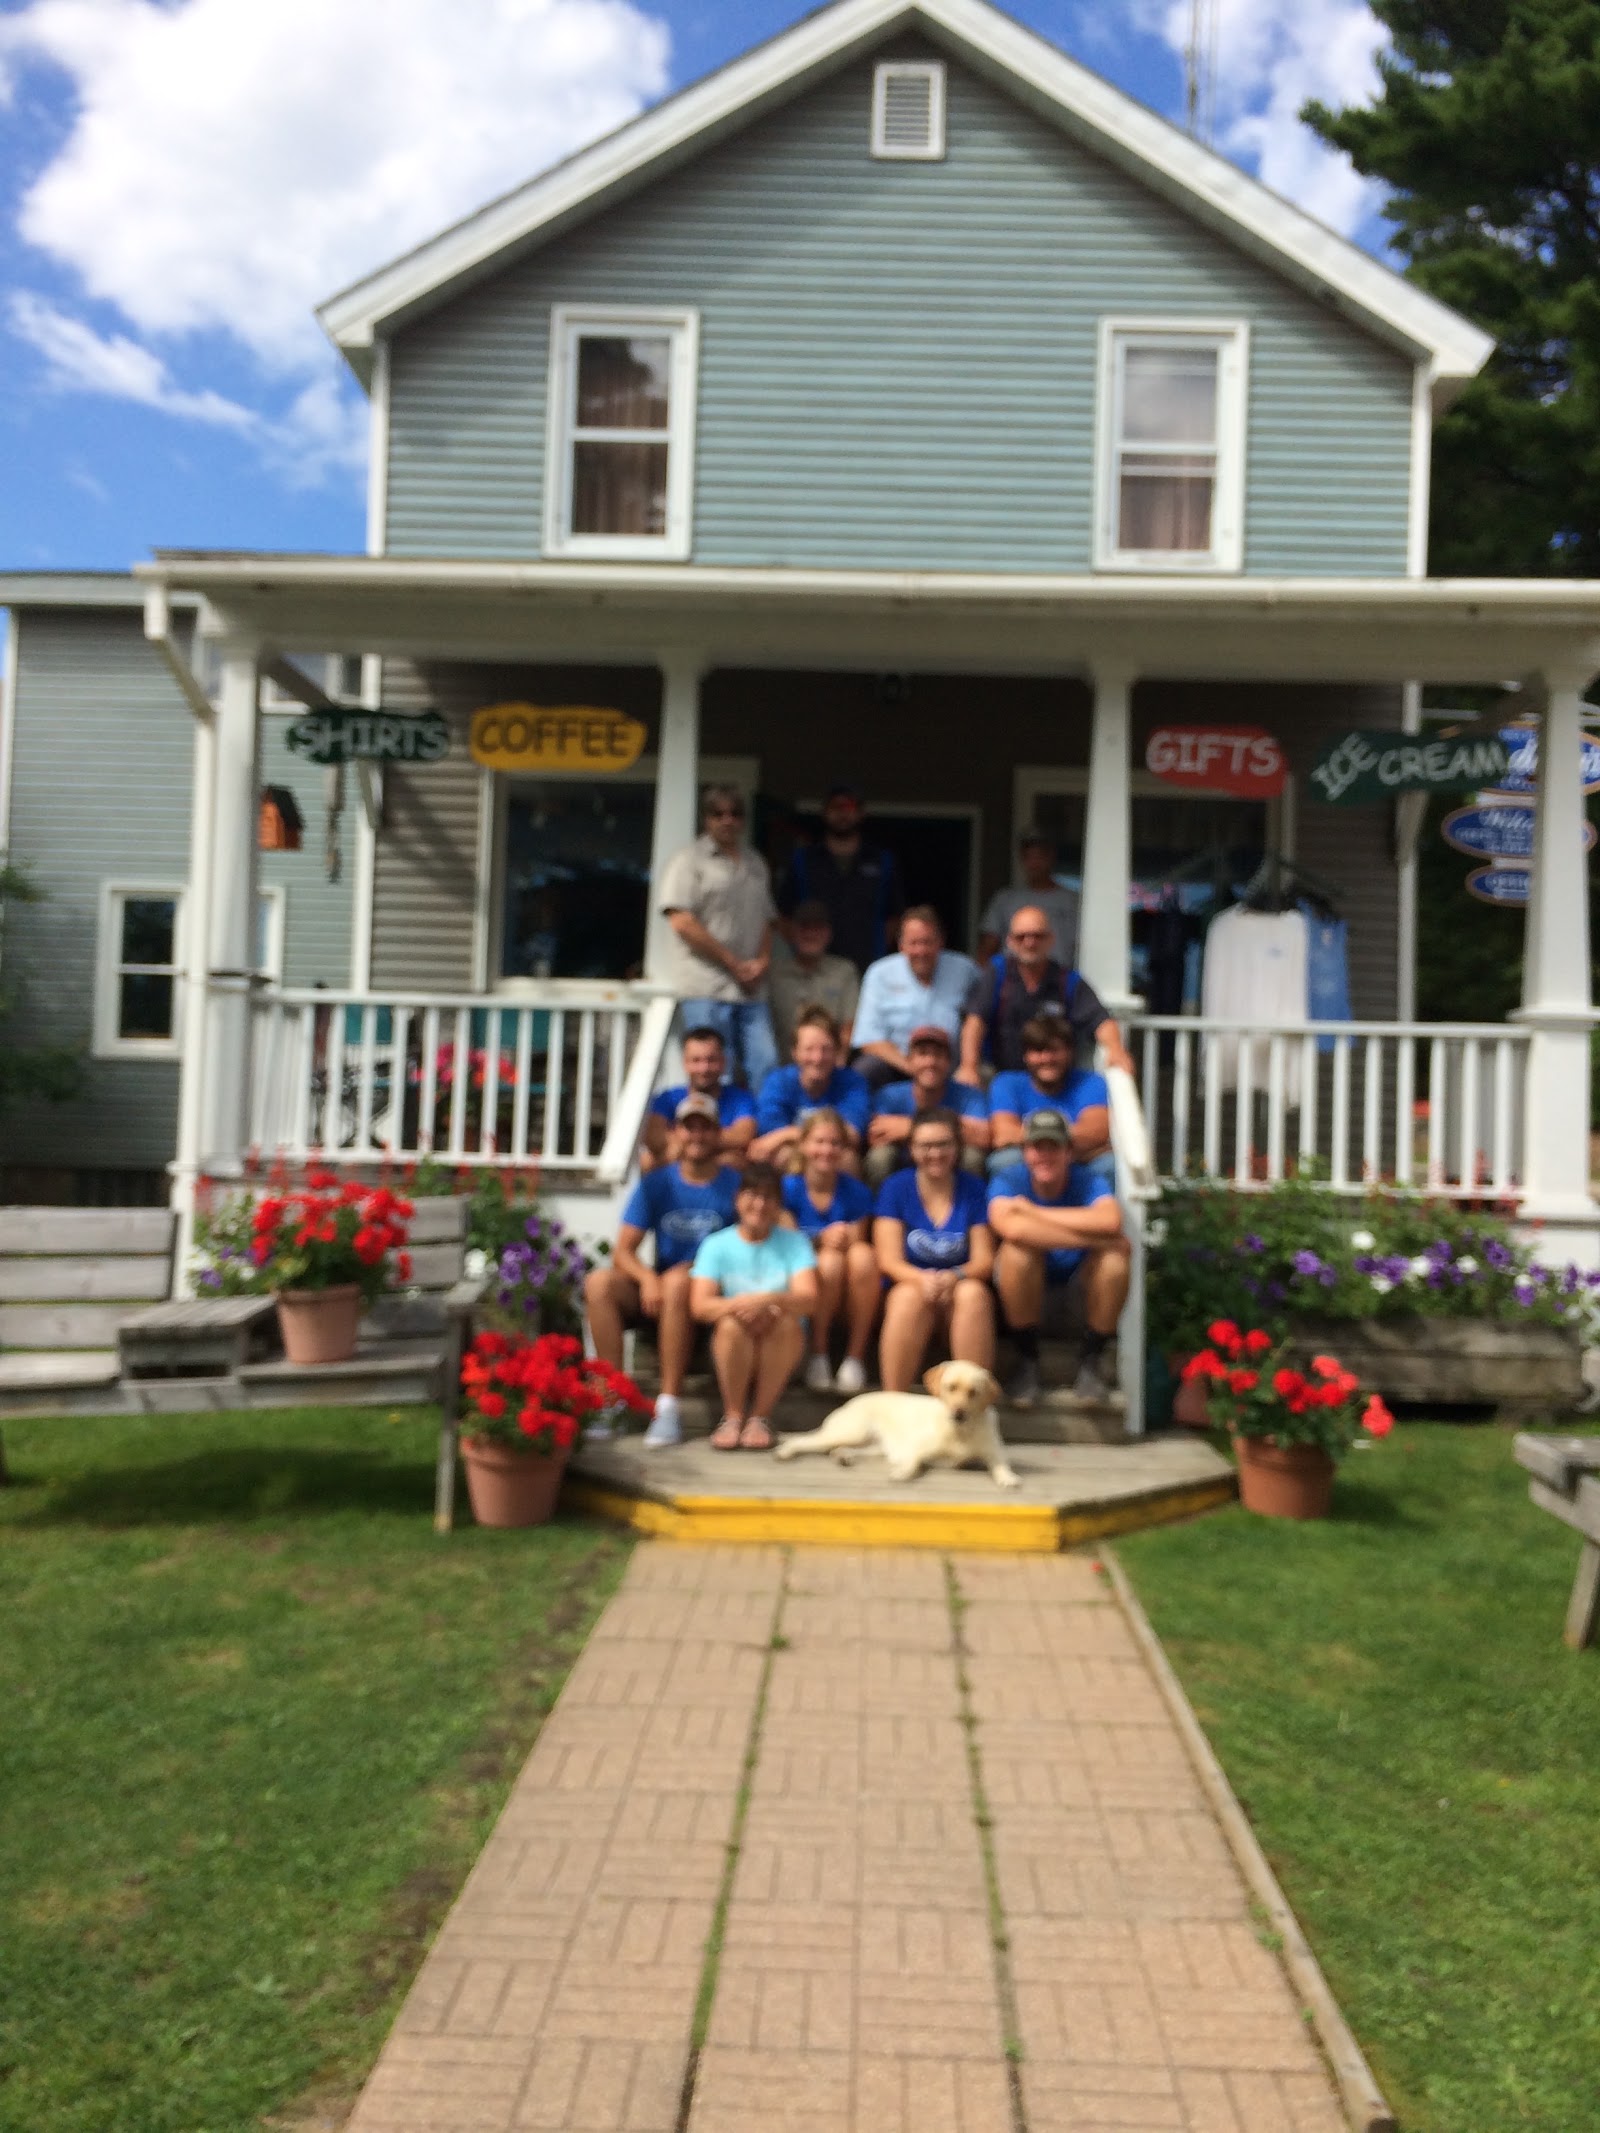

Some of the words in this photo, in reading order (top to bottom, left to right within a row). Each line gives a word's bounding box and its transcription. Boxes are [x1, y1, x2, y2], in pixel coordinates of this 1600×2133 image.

[300, 716, 448, 760] SHIRTS
[477, 717, 631, 758] COFFEE
[1147, 731, 1281, 776] GIFTS
[1311, 732, 1379, 801] ICE
[1378, 741, 1506, 785] CREAM
